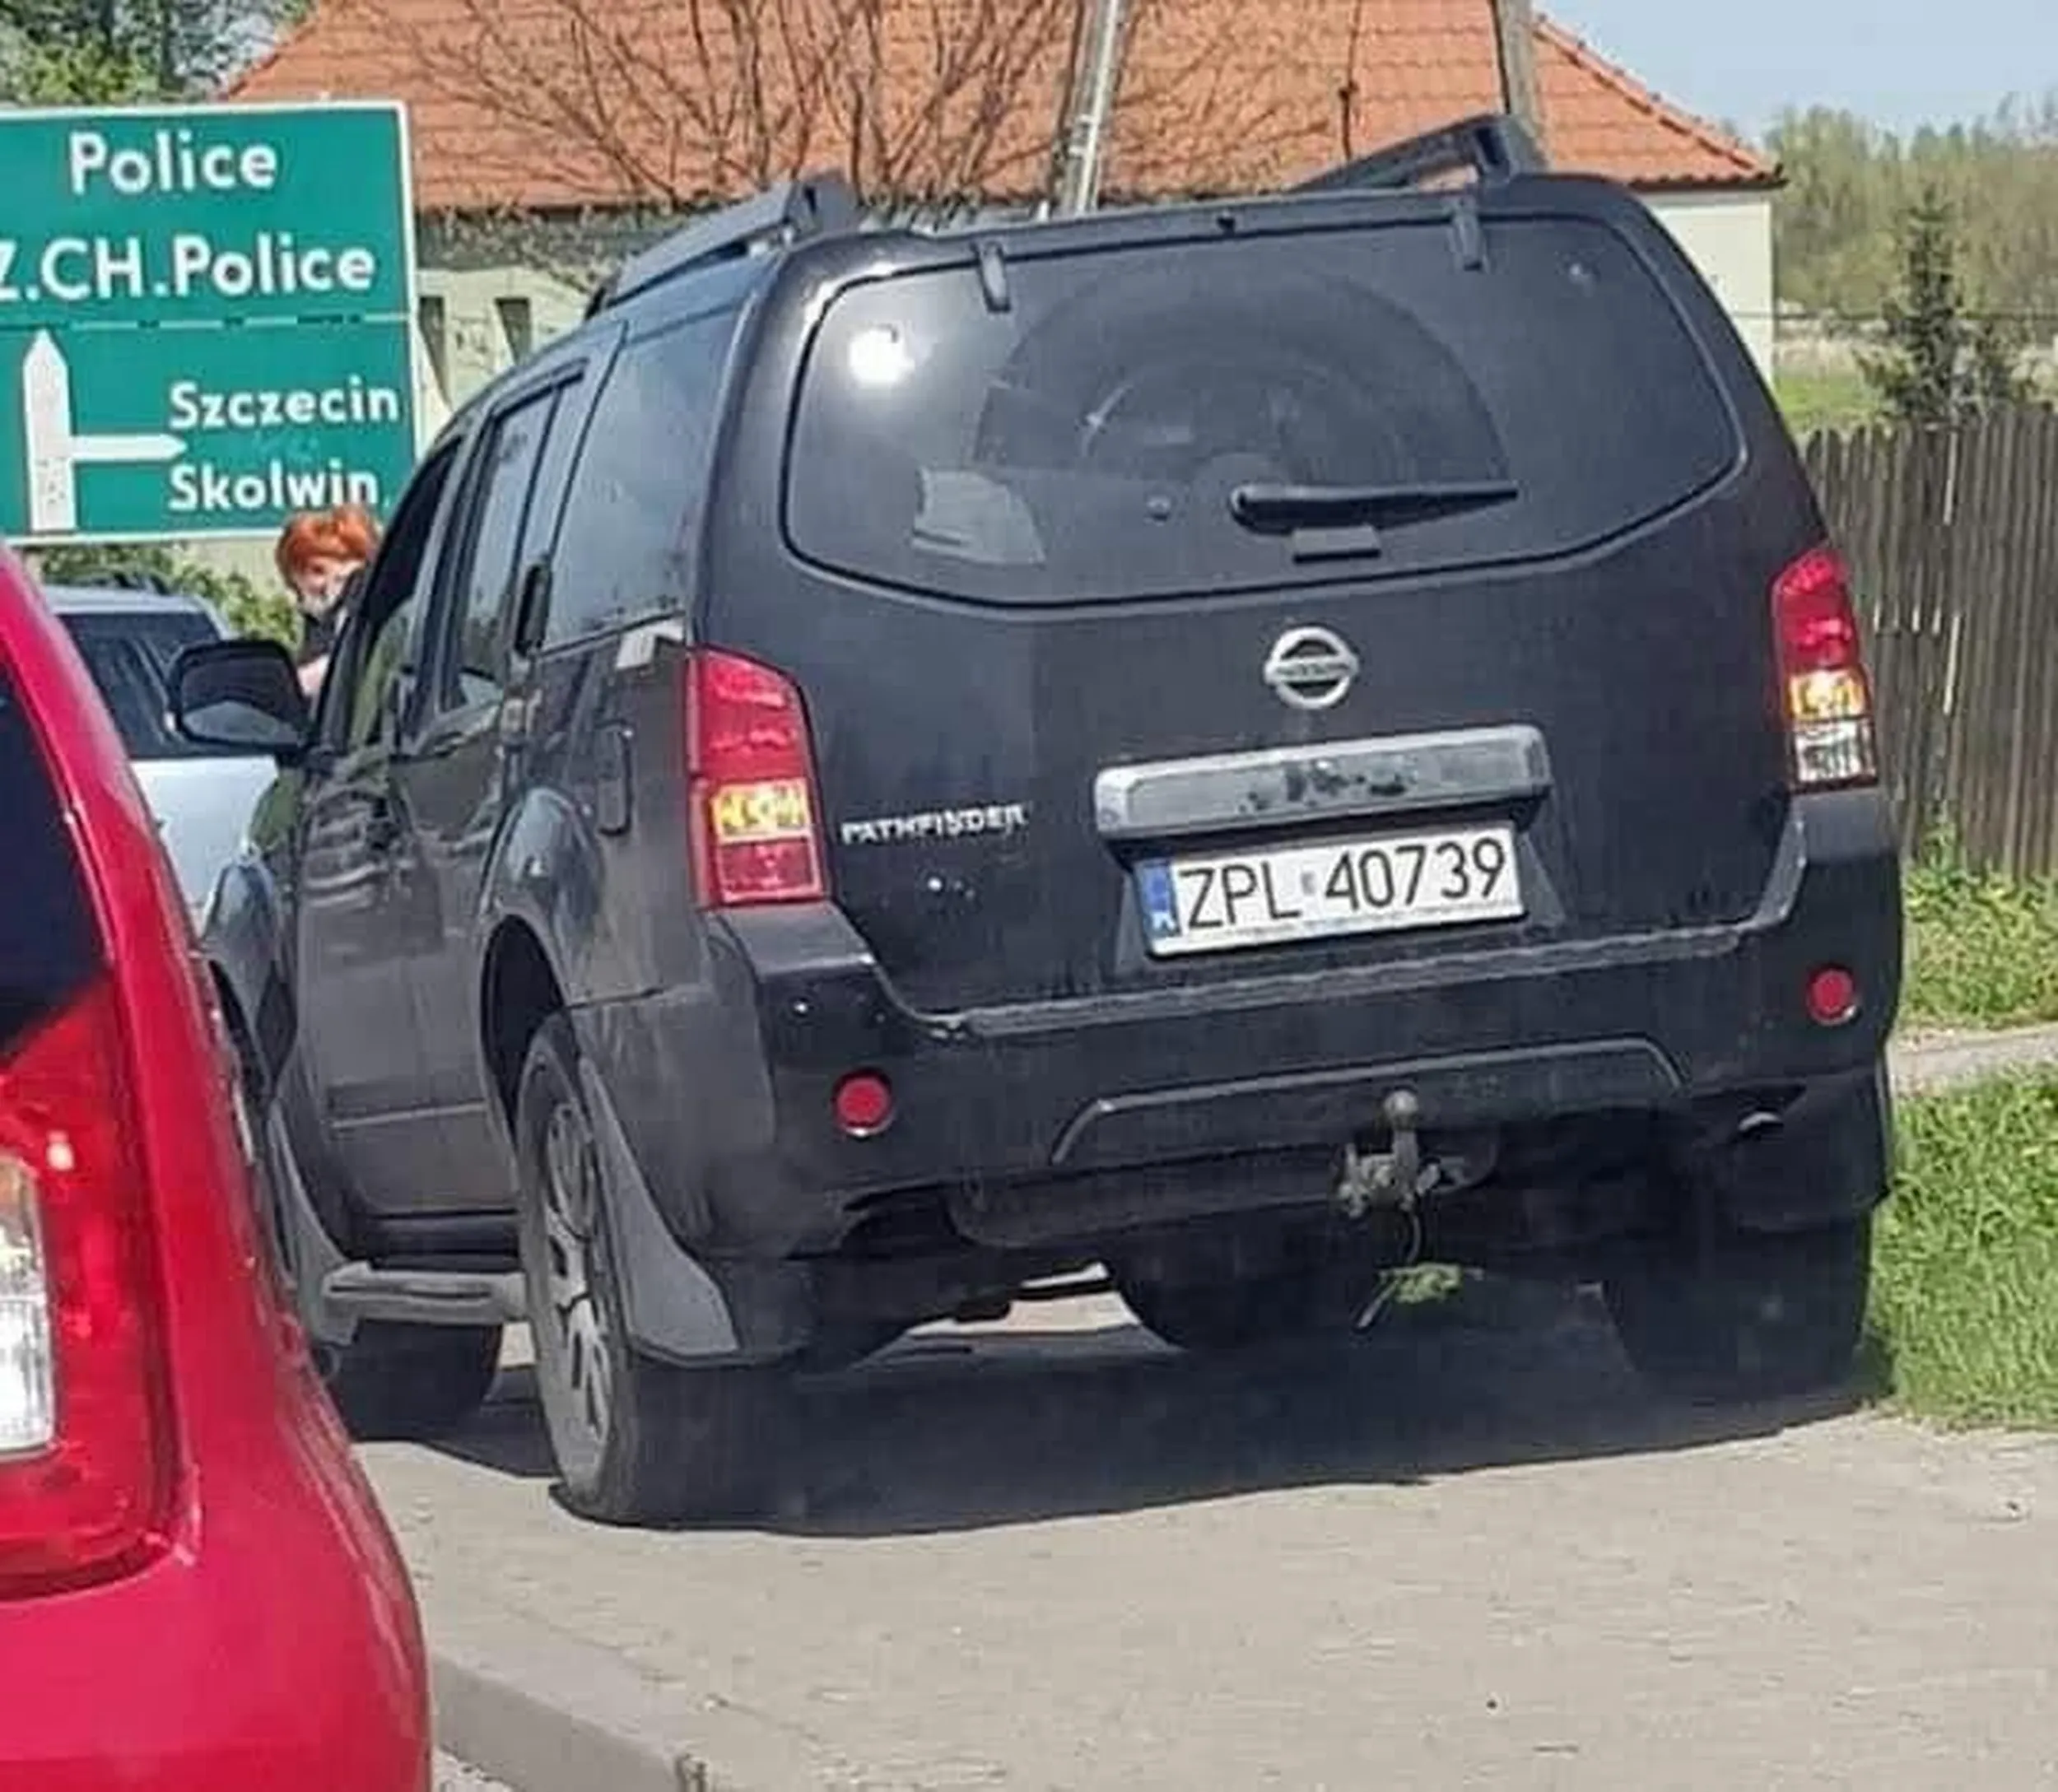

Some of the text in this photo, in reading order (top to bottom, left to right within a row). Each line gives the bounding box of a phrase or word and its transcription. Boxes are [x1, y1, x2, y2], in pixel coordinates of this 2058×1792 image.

[69, 129, 277, 194] Police
[169, 375, 399, 429] Szczecin
[168, 458, 379, 511] Skolwin
[1179, 837, 1506, 929] ZPL 40739
